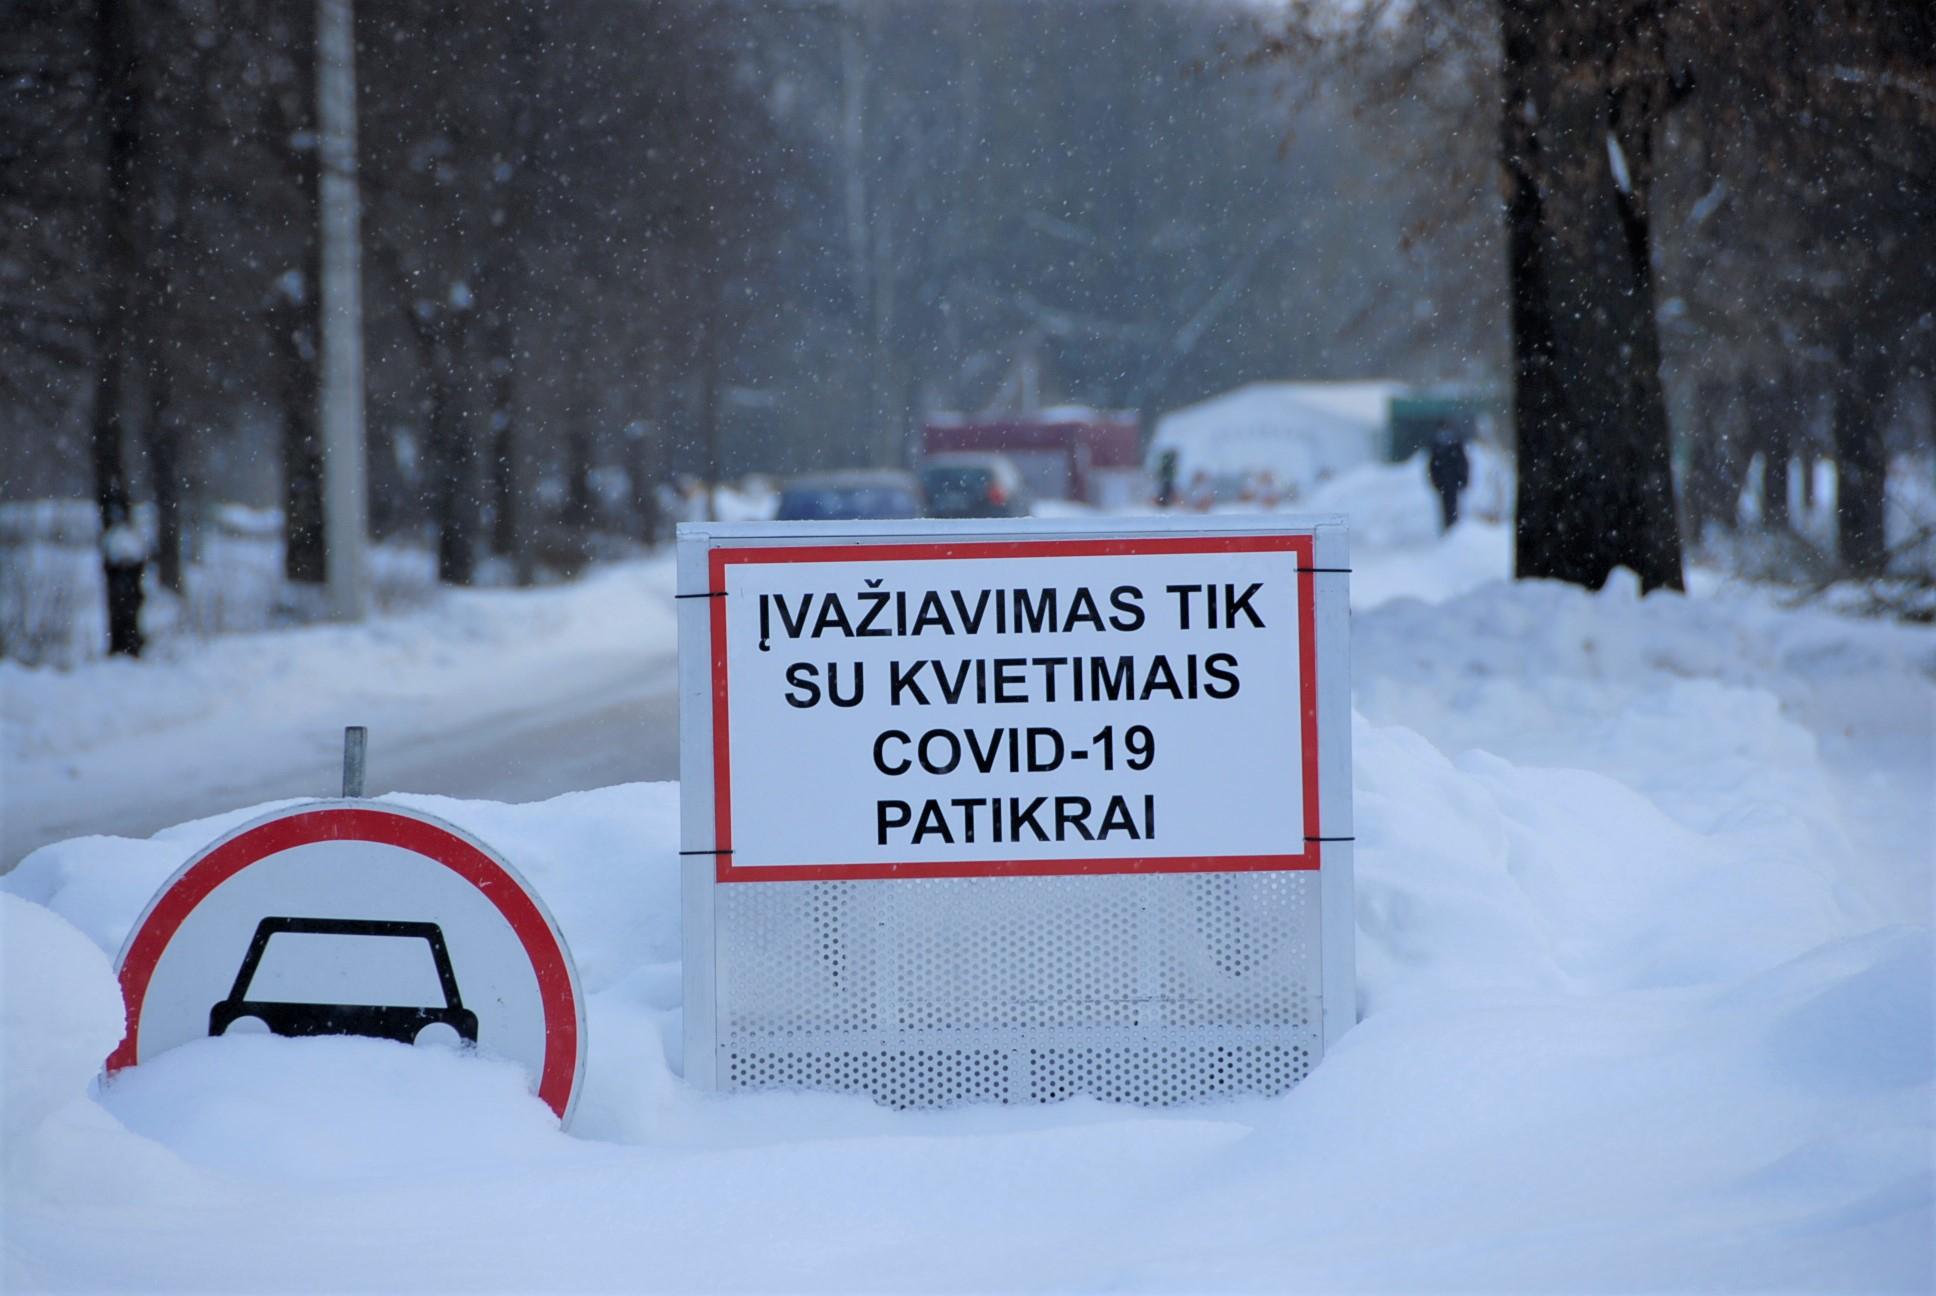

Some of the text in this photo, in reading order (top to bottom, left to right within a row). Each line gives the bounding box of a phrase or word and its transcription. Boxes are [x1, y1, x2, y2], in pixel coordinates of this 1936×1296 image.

[759, 578, 1266, 652] ĮVAŽIAVIMAS TIK
[785, 652, 1241, 709] SU KVIETIMAIS
[872, 724, 1155, 777] COVID-19
[876, 794, 1155, 846] PATIKRAI
